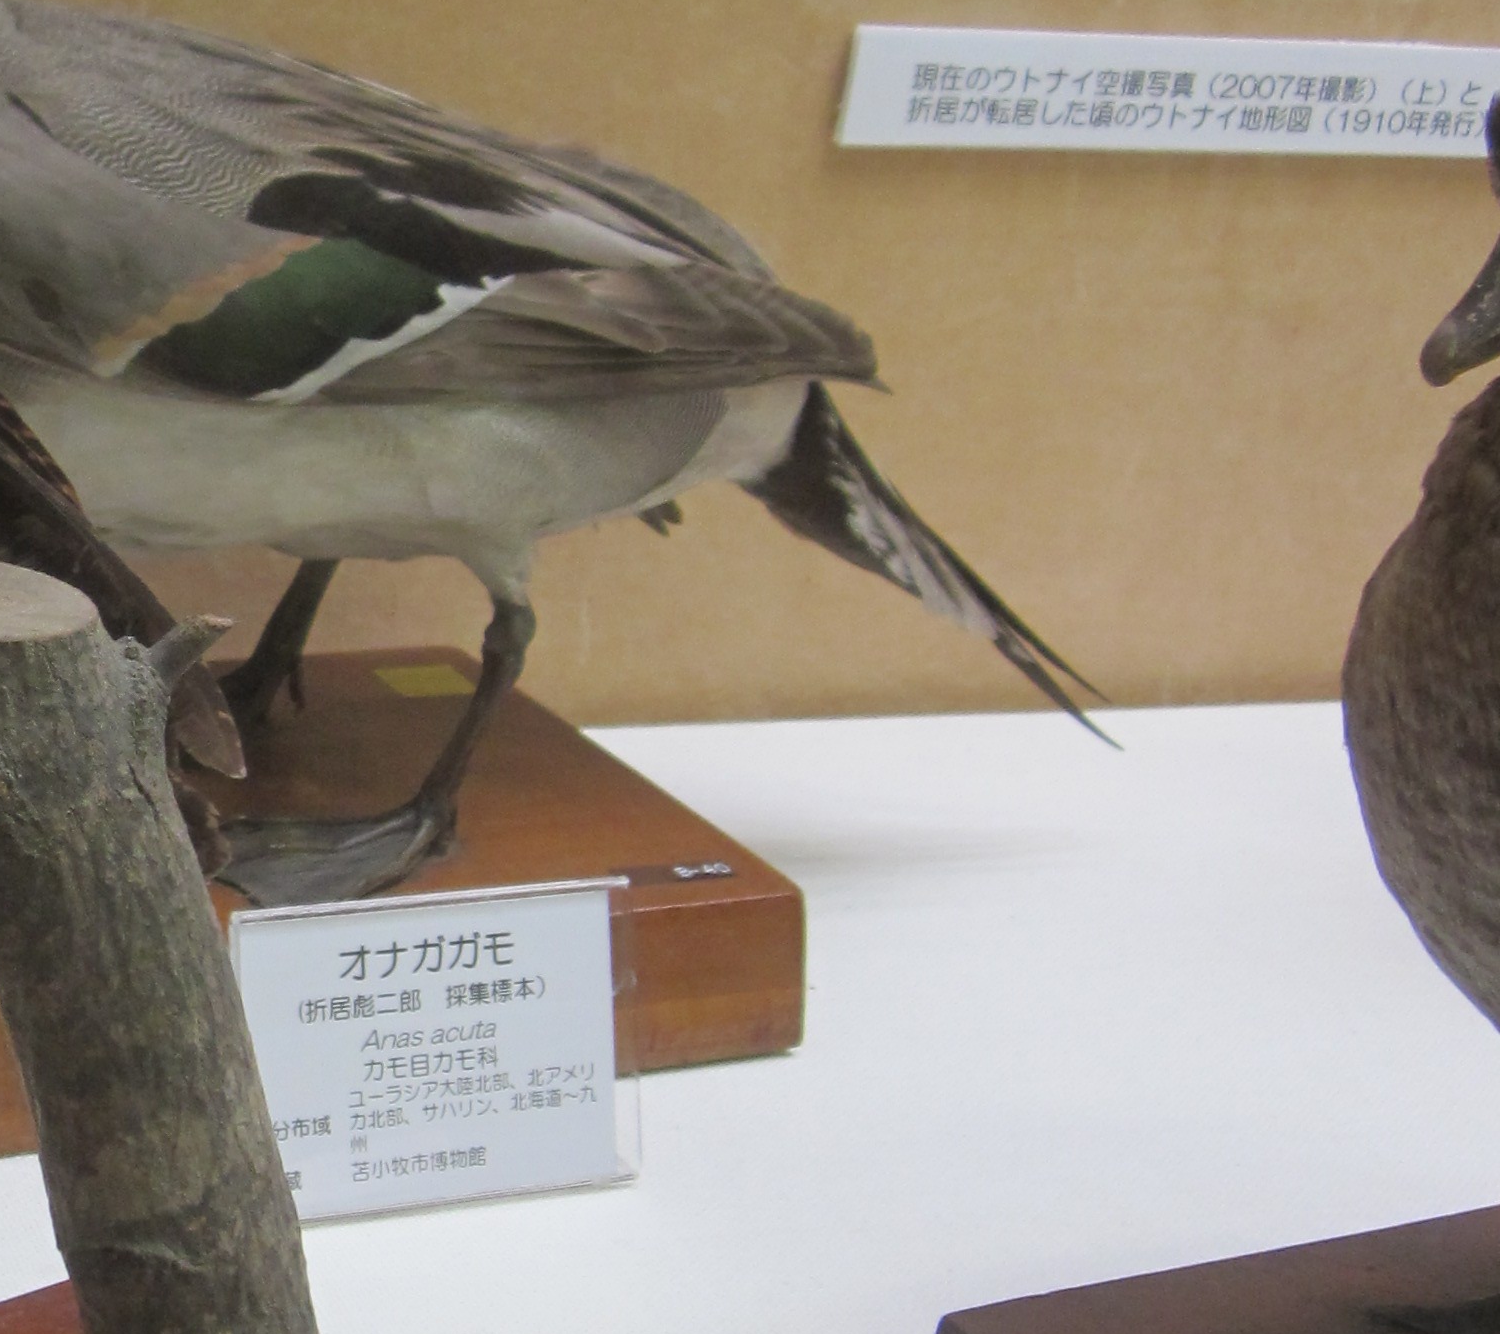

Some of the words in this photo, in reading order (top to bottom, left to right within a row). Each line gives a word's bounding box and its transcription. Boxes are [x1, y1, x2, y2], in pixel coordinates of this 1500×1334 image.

[339, 931, 515, 981] オナガガモ
[445, 975, 546, 1009] 採集標本)
[360, 1029, 423, 1053] Anas
[430, 1019, 497, 1045] acuta
[363, 1045, 499, 1082] カモ目カモ科
[348, 1062, 596, 1109] ユーラシア大陸北部、北アメリ
[350, 1134, 369, 1154] 州
[351, 1146, 488, 1183] 苫小牧市博物館
